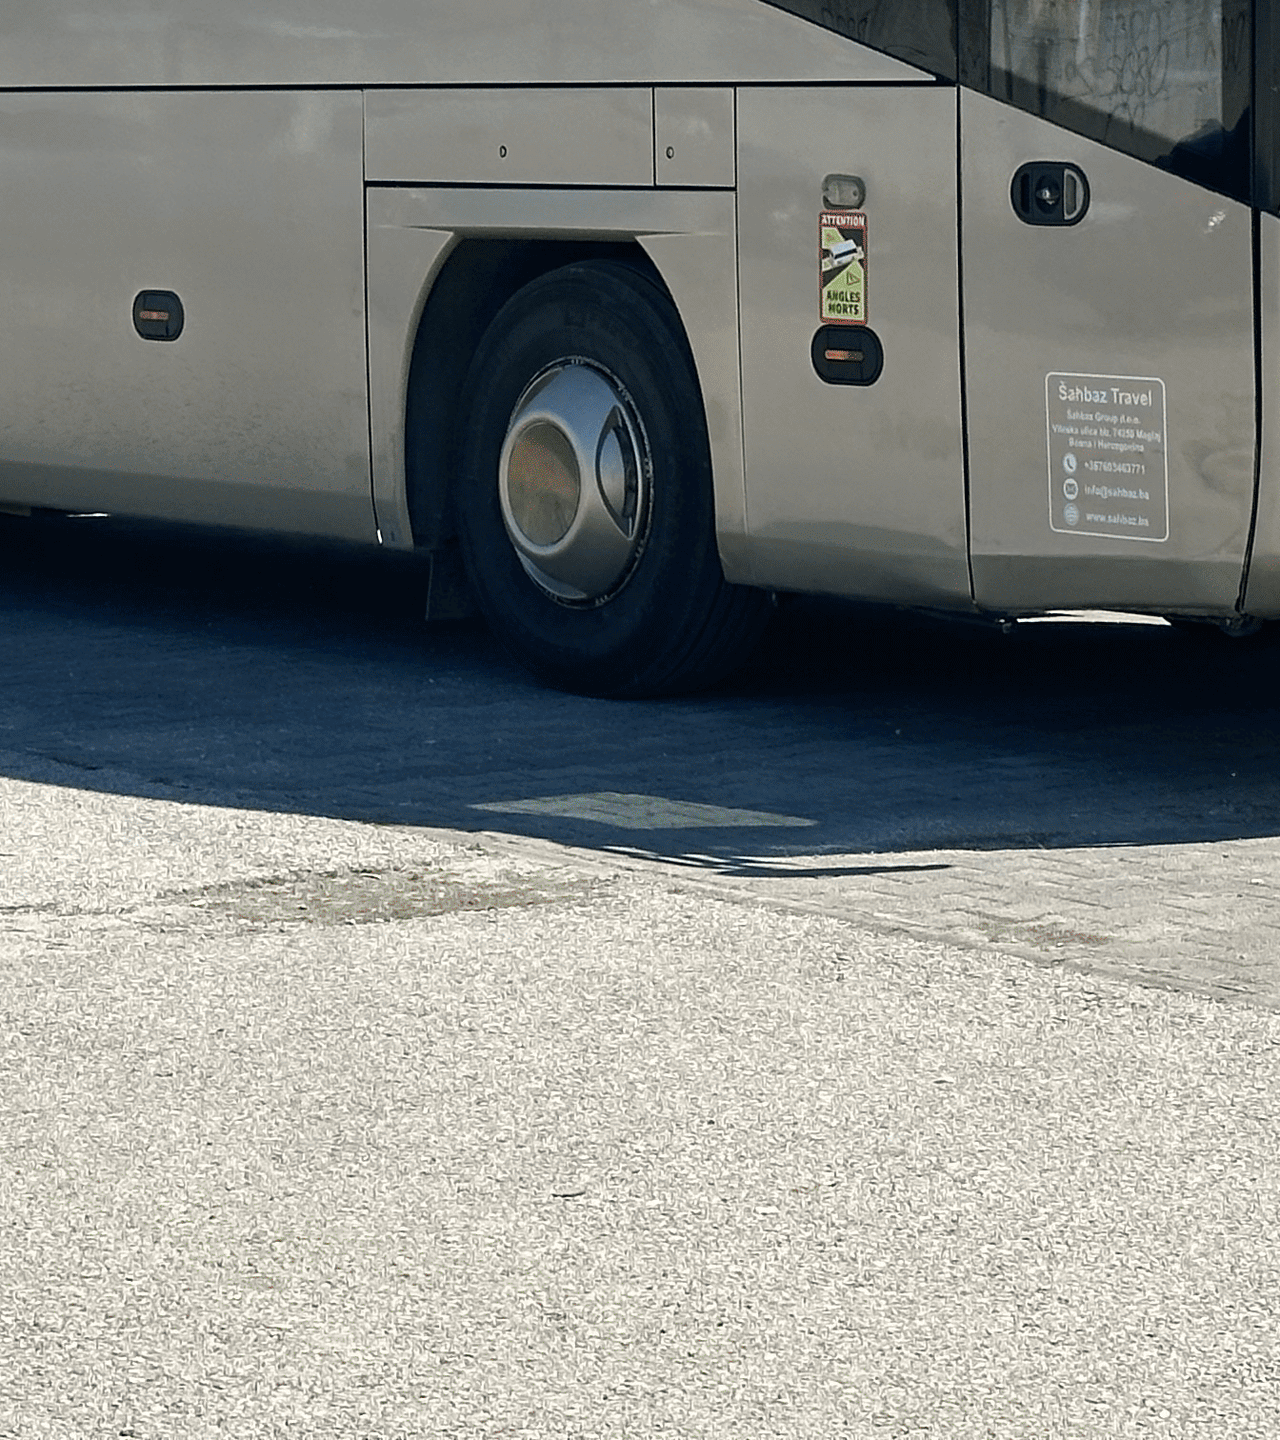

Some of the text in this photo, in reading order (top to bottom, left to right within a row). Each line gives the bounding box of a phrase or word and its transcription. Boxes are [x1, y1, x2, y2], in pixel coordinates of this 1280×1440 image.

[822, 215, 865, 227] ATTENTION
[826, 290, 860, 303] ANGLES
[828, 303, 859, 315] MORTS
[1058, 381, 1152, 407] Šahbaz Travel
